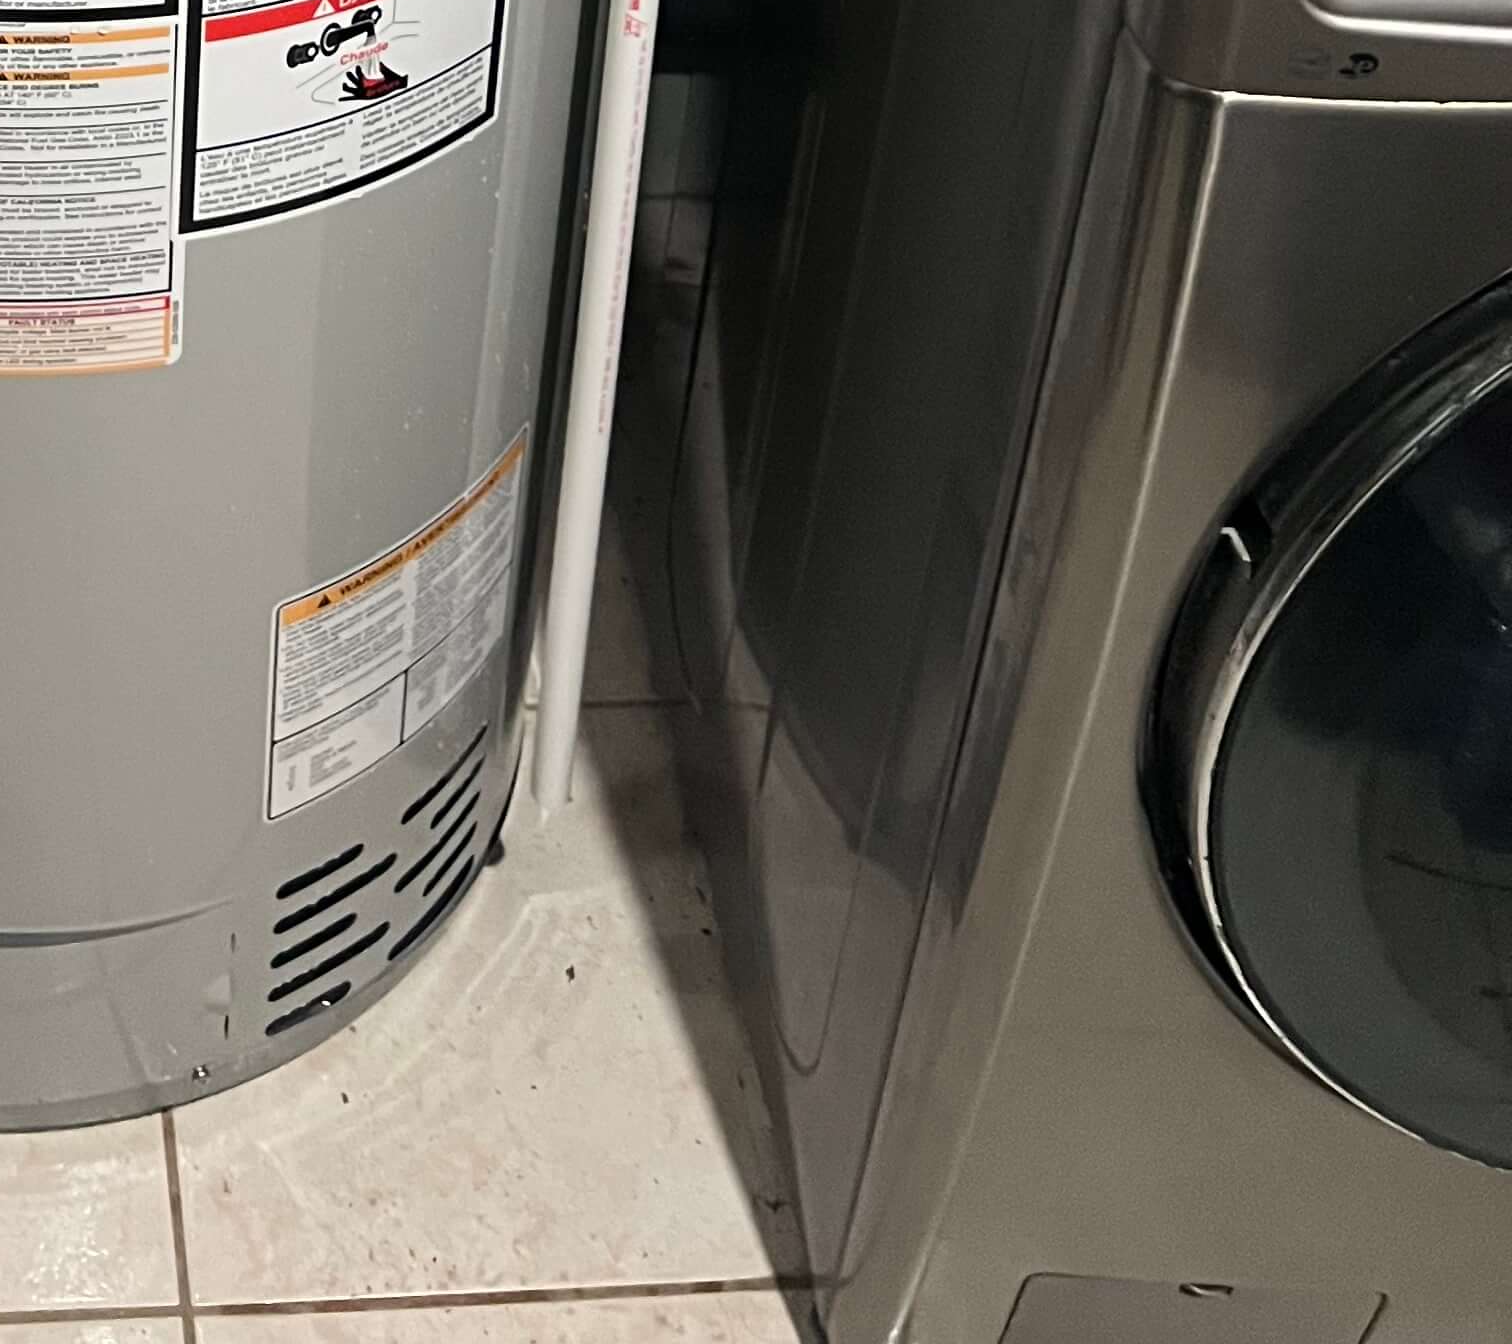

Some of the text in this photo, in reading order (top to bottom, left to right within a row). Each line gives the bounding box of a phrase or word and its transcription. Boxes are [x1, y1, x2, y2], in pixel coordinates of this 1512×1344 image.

[12, 35, 72, 45] WARNING
[340, 41, 389, 65] Chaude
[13, 72, 71, 82] WARNING
